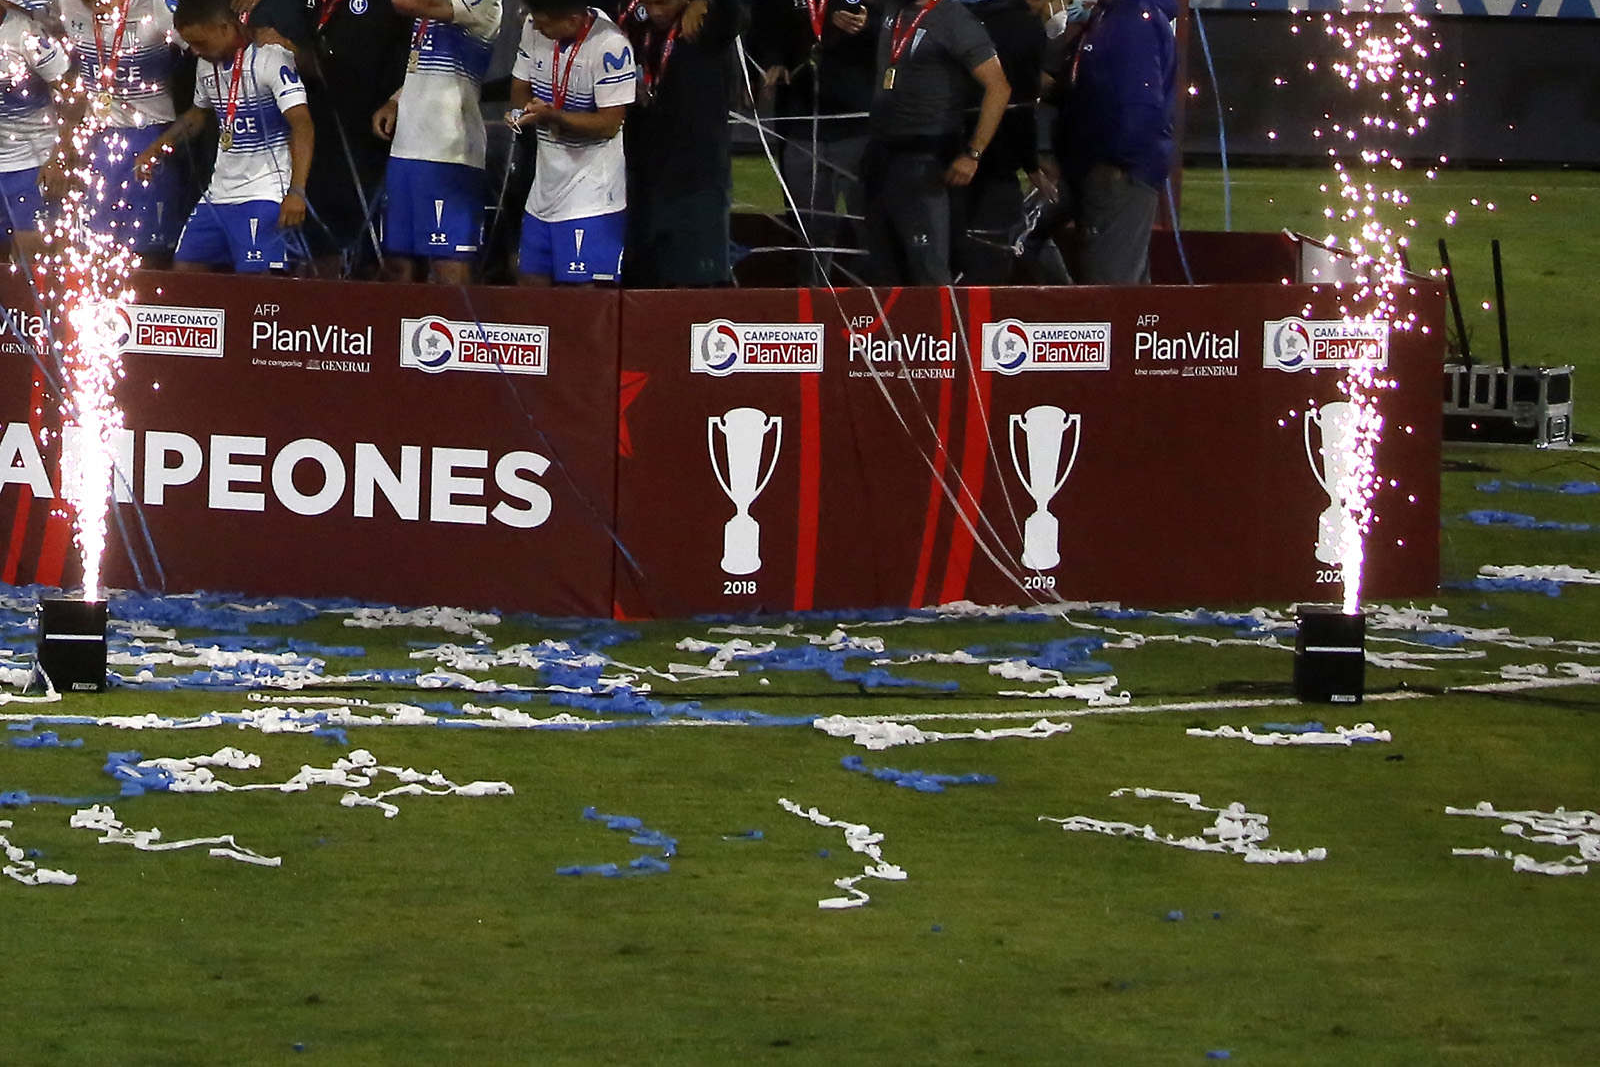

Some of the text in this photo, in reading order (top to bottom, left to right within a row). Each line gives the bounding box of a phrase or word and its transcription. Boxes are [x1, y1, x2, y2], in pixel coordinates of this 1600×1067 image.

[92, 64, 142, 82] BCE
[254, 304, 280, 317] AFP
[136, 312, 218, 327] CAMPEONATO
[851, 316, 875, 328] AFP
[1137, 315, 1160, 327] AFP
[137, 326, 217, 349] PlanVital
[252, 321, 372, 356] PlanVital
[459, 329, 542, 344] CAMPEONATO
[744, 331, 818, 342] CAMPEONATO
[1033, 330, 1105, 341] CAMPEONATO
[1, 343, 50, 356] GENEALI
[849, 332, 957, 363] PlanVital
[1034, 342, 1103, 362] PlanVital
[1134, 330, 1240, 361] PlanVital
[1315, 340, 1383, 360] PlanVil
[461, 343, 541, 366] PlanVital
[745, 344, 817, 364] PlanVital
[321, 360, 370, 373] GENERALI
[911, 369, 956, 379] GENERALI
[1195, 366, 1239, 376] GENERALI
[1023, 575, 1056, 590] 2019
[1316, 569, 1345, 583] 202
[723, 581, 757, 595] 2018
